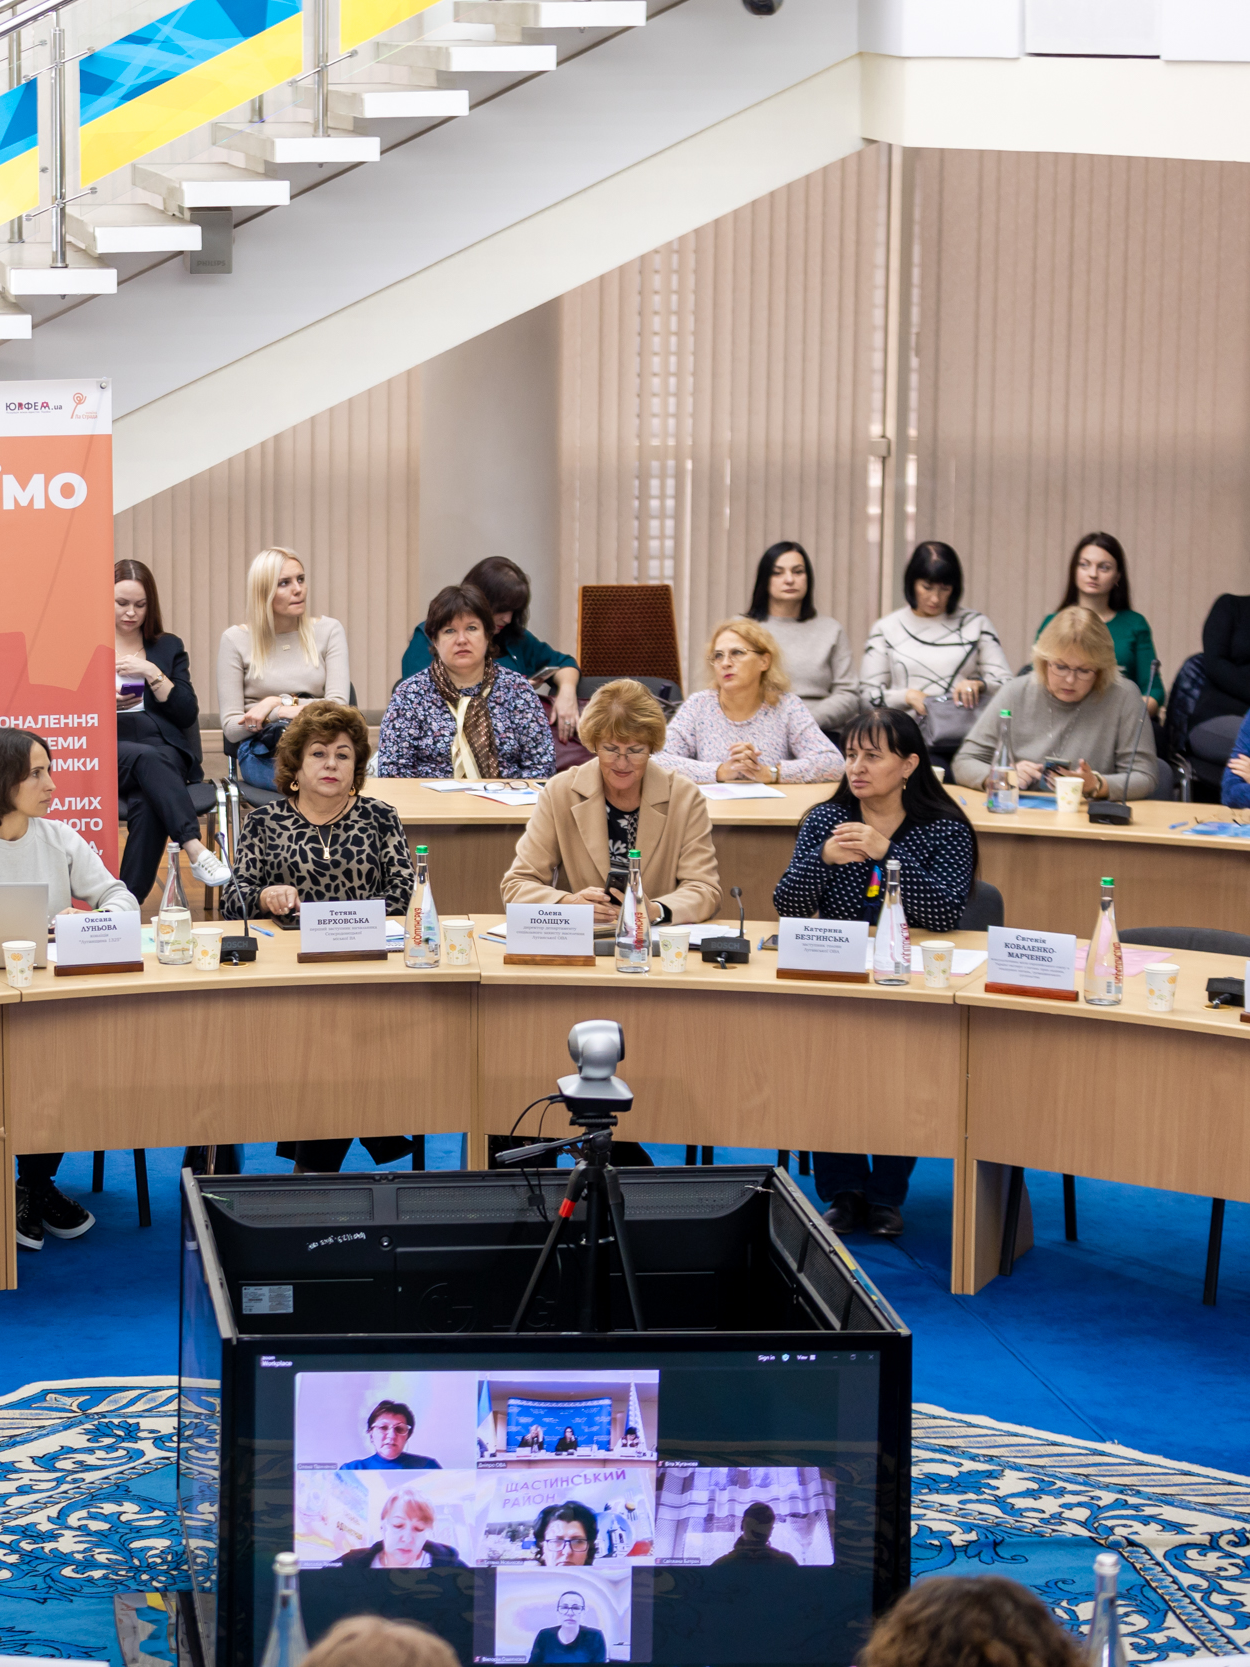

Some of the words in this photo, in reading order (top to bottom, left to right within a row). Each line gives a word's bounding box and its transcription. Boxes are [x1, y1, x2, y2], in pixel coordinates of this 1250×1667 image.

[329, 909, 357, 917] Тетяна
[84, 916, 112, 924] Оксана
[317, 917, 370, 926] ВЕРХОВСЬКА
[530, 918, 570, 926] ПОЛІЩУК
[81, 924, 117, 933] ЛУНЬОВА
[803, 925, 843, 934] Катерина
[795, 933, 850, 943] БЕЗГИНСЬКА
[1015, 934, 1047, 945] Євгенія
[711, 941, 740, 950] BOSCH
[1004, 942, 1057, 954] КОВАЛЕНКО-
[1007, 951, 1053, 963] МАРЧЕНКО
[758, 1354, 770, 1362] Sign
[261, 1360, 293, 1368] Workplace
[505, 1467, 627, 1493] ЩАСТИНСЬКИЙ
[502, 1493, 556, 1509] РАЙОН
